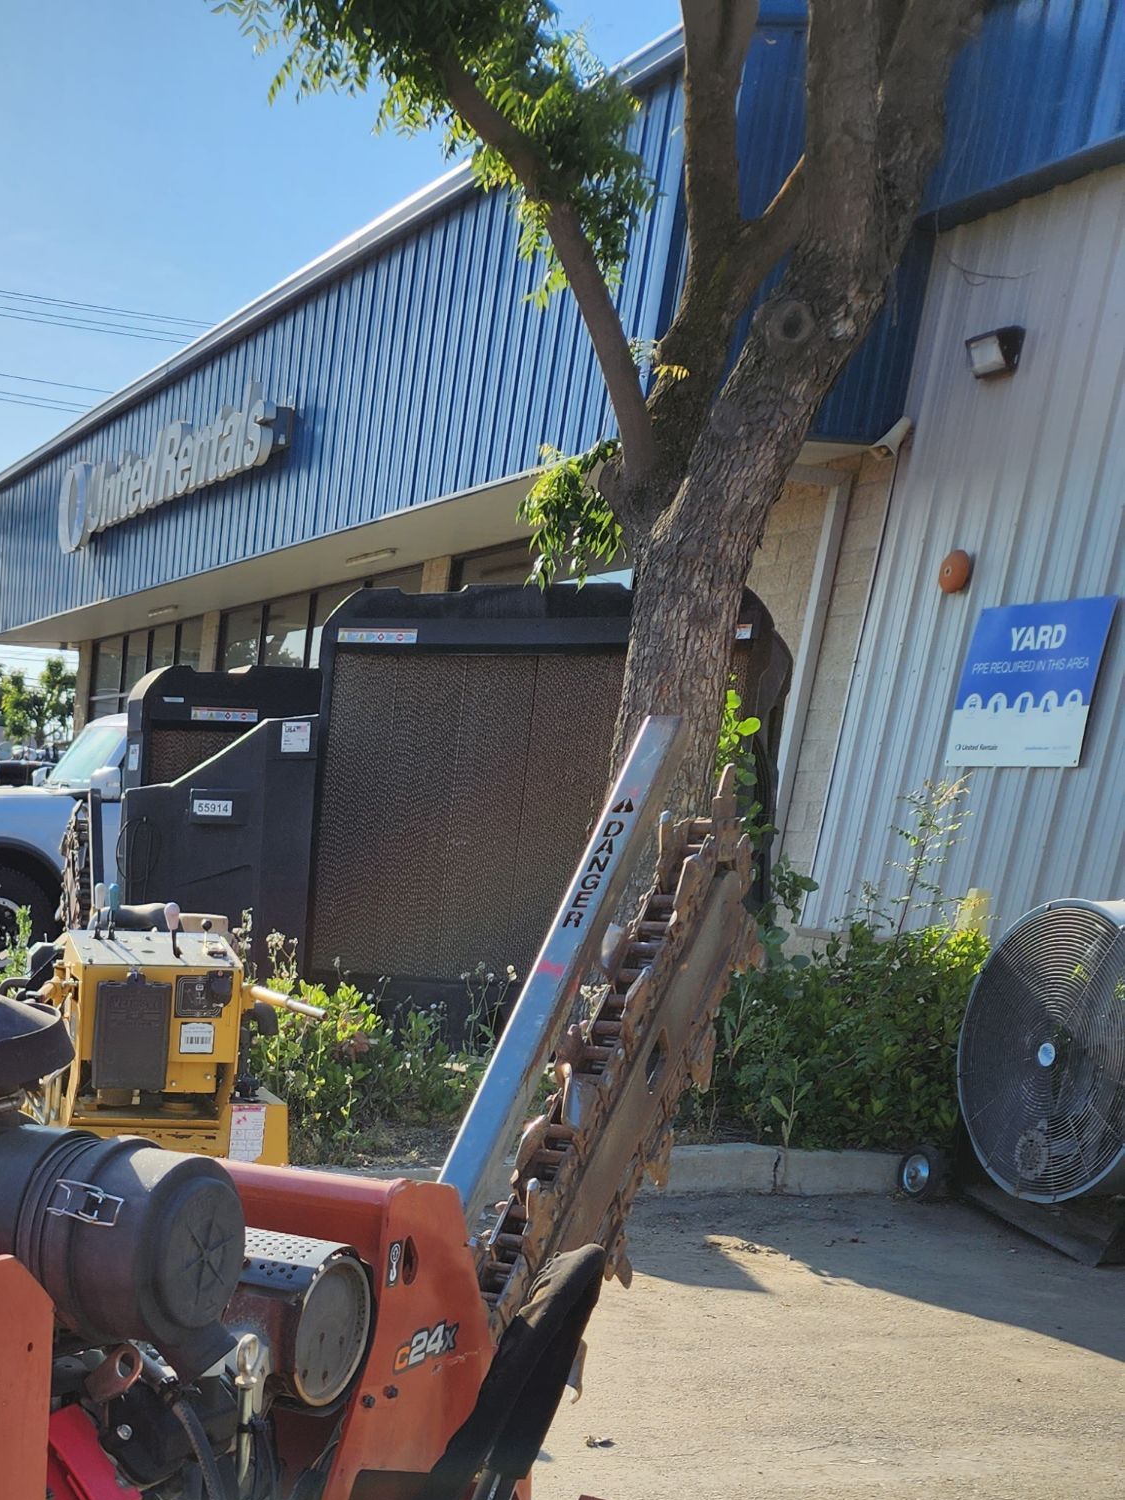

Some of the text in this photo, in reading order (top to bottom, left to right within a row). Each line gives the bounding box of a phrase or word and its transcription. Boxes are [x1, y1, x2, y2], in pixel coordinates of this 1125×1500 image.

[87, 382, 277, 533] United Rentals
[1011, 624, 1066, 651] YARD
[972, 657, 1089, 675] PPE REQUIRED IN THIS AREA
[198, 803, 229, 814] 55914
[562, 821, 625, 928] DANGER
